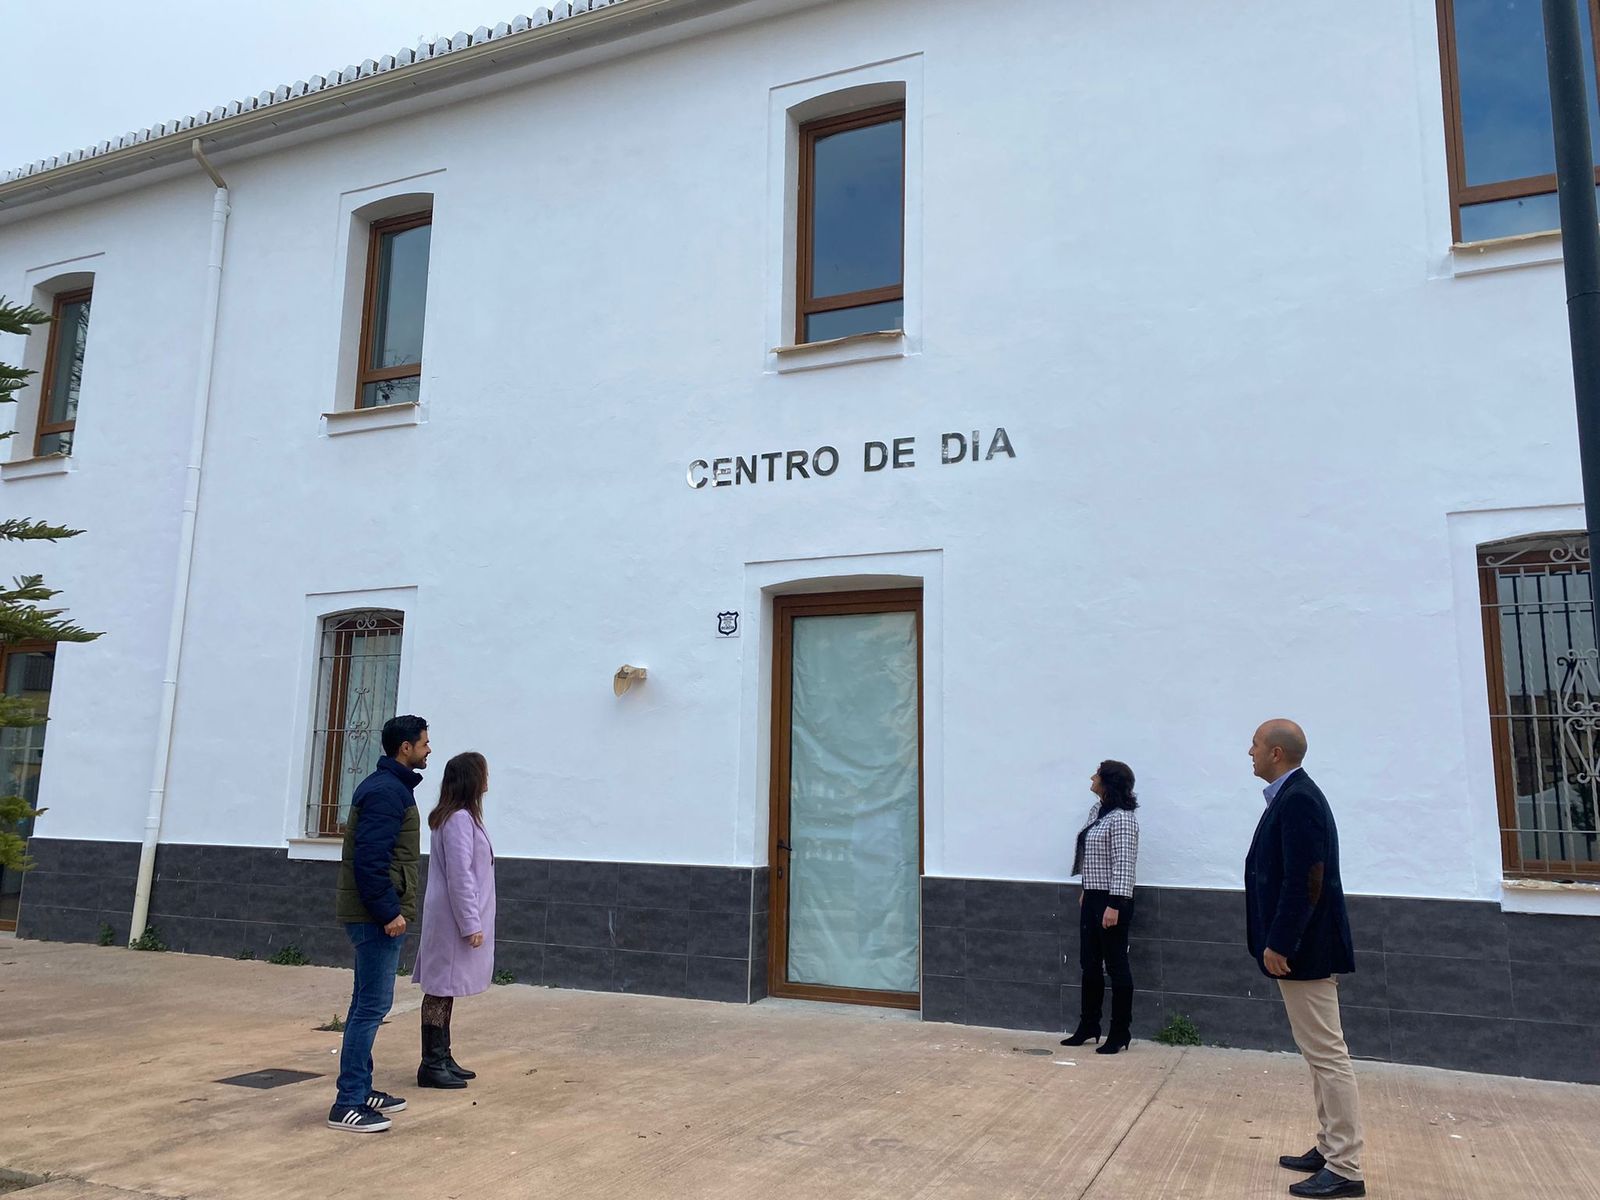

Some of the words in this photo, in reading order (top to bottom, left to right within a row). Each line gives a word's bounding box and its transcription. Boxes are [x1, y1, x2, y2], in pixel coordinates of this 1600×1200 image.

[686, 445, 840, 489] CENTRO
[863, 436, 916, 473] DE
[940, 427, 1017, 465] DIA
